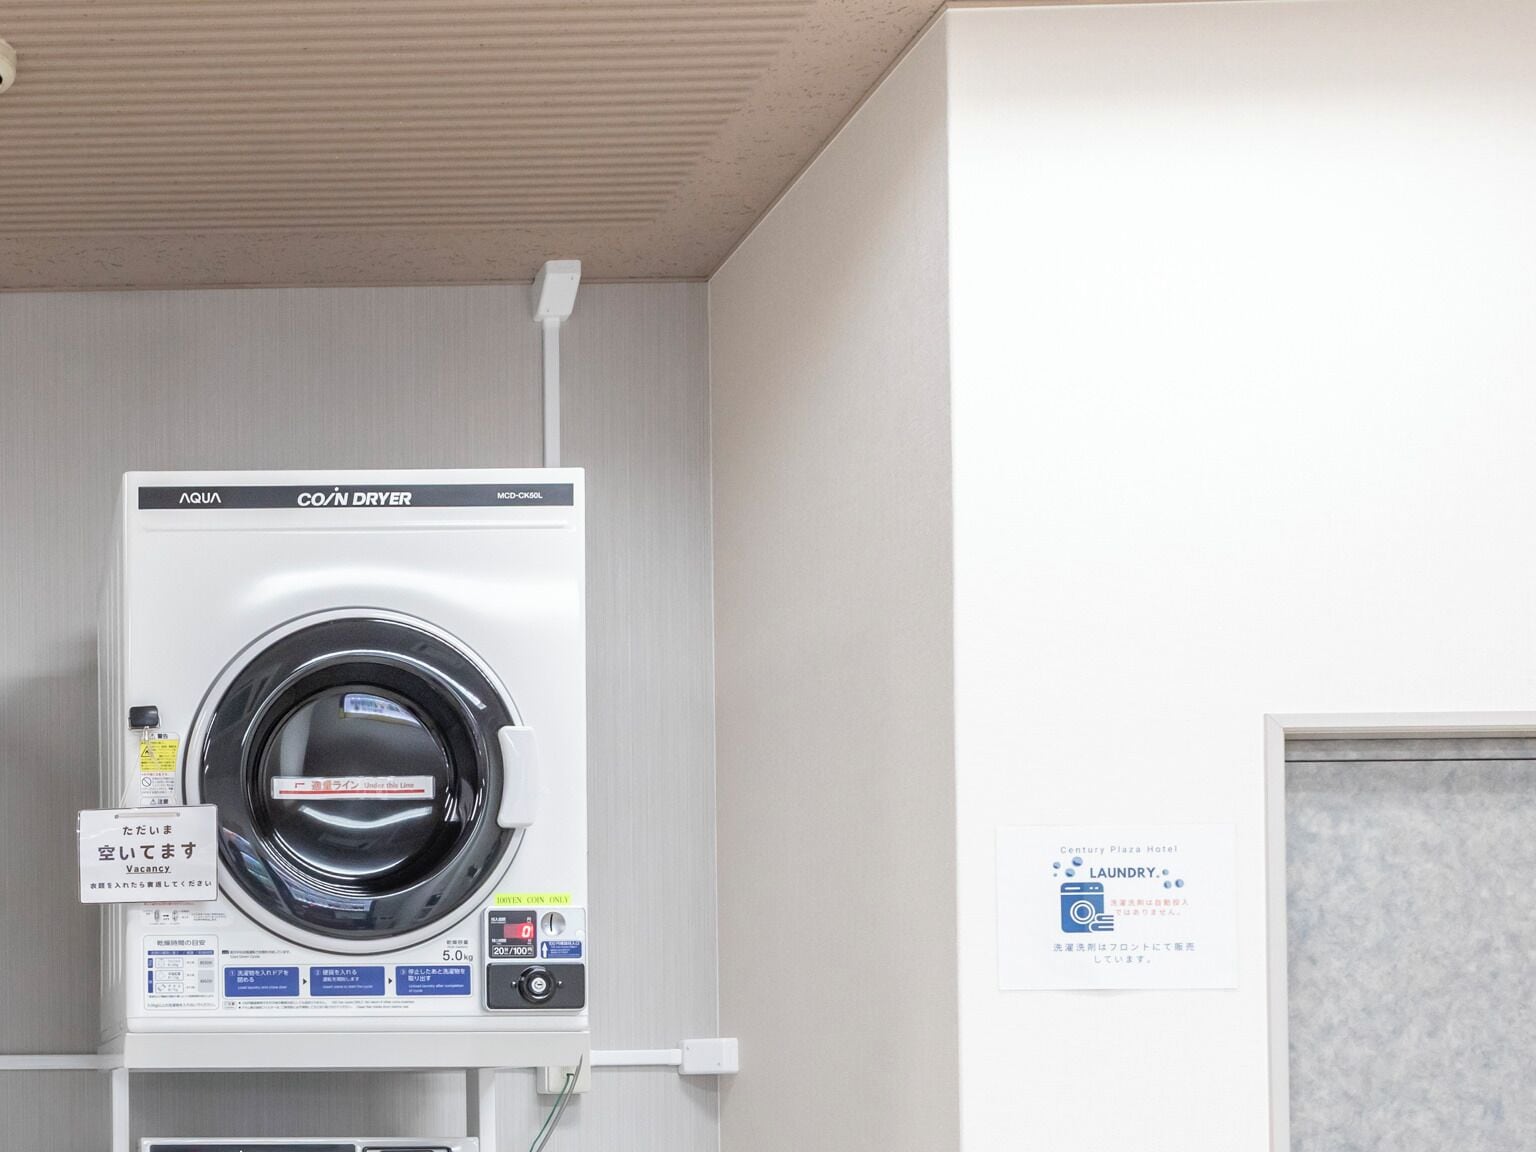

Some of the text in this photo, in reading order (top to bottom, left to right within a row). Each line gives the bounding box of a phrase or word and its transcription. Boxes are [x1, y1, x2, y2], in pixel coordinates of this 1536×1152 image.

[179, 493, 222, 504] AQUA
[353, 492, 412, 506] DRYER
[122, 825, 172, 836] ただいま
[97, 842, 196, 861] 空いてます
[1060, 845, 1177, 855] Century Plaza Hotel
[126, 865, 171, 873] Vacancy
[1090, 867, 1160, 878] LAUNDRY.
[522, 926, 531, 938] 0
